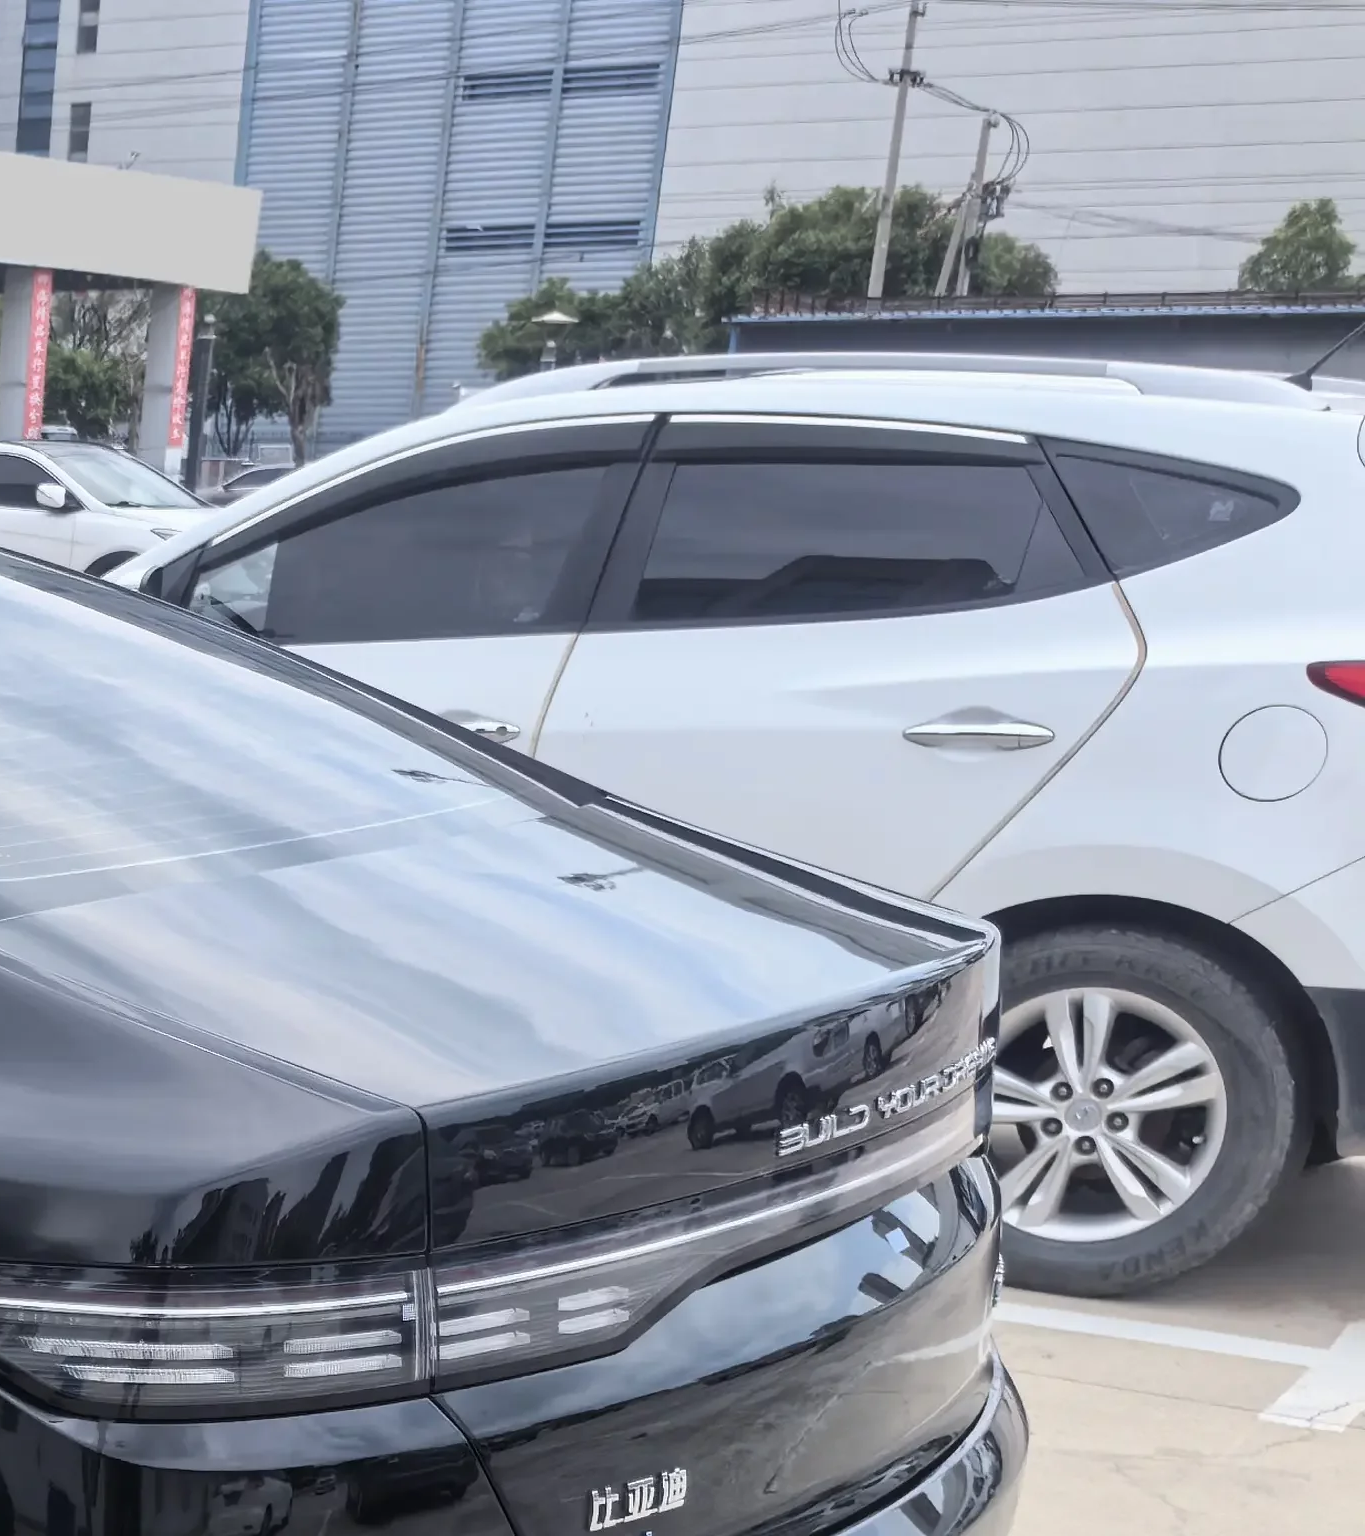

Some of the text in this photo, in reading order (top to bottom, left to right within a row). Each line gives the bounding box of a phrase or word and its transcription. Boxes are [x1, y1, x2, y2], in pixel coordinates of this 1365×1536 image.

[778, 1103, 870, 1157] BUILD
[876, 1075, 942, 1119] YOUR
[589, 1467, 688, 1532] 比亚迪
